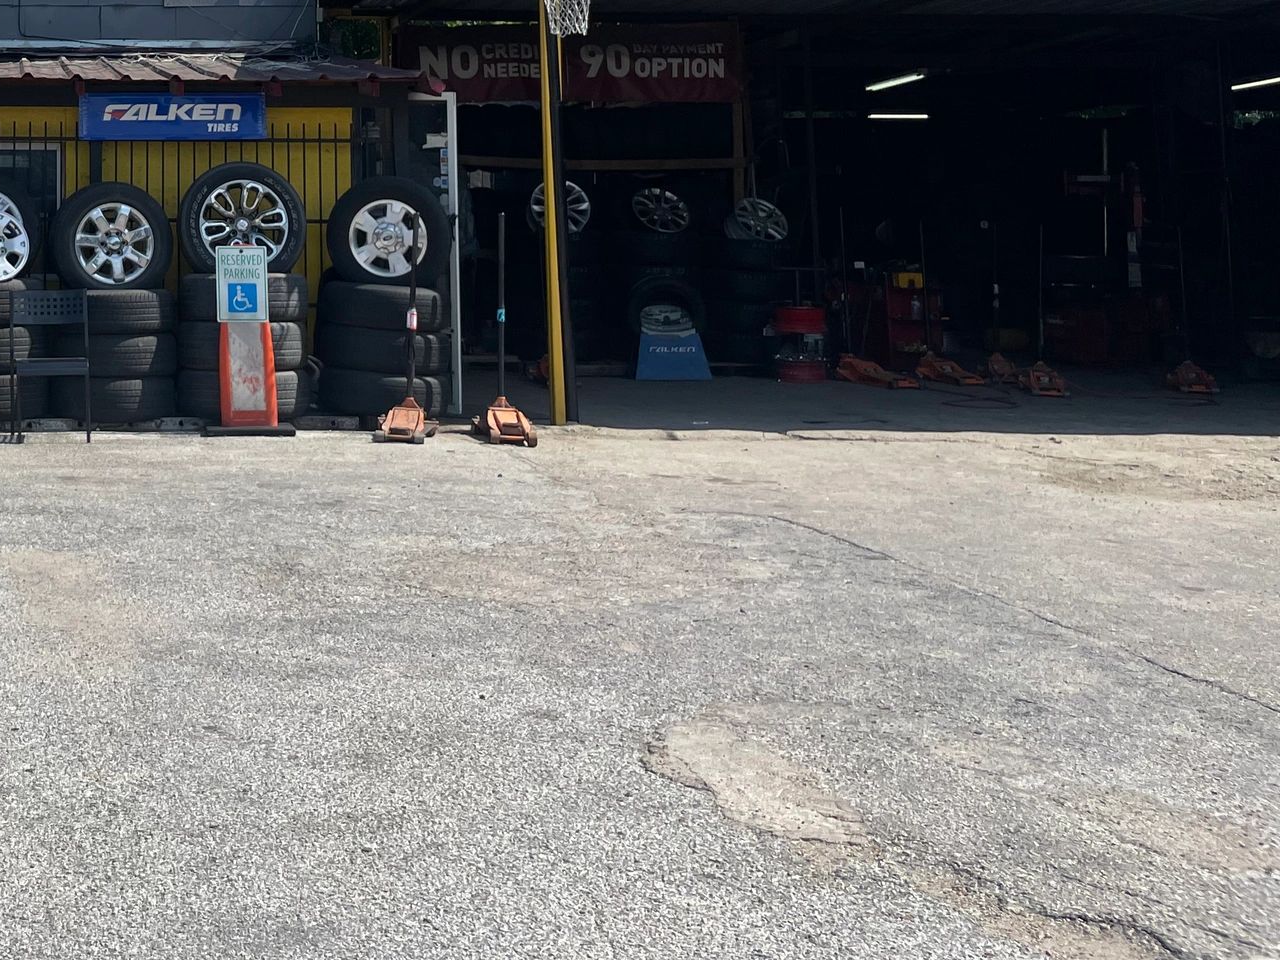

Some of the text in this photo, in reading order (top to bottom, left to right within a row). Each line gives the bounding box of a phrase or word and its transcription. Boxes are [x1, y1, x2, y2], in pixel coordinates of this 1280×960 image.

[481, 43, 540, 59] CREDI
[633, 43, 724, 55] DAY PAYMENT
[418, 44, 479, 80] NO
[579, 43, 631, 79] 90
[634, 57, 725, 79] OPTION
[483, 62, 541, 79] NEEDE
[102, 103, 242, 121] FALKEN
[207, 122, 239, 133] TIRES
[220, 254, 263, 266] RESERVED
[223, 268, 261, 280] PARKING
